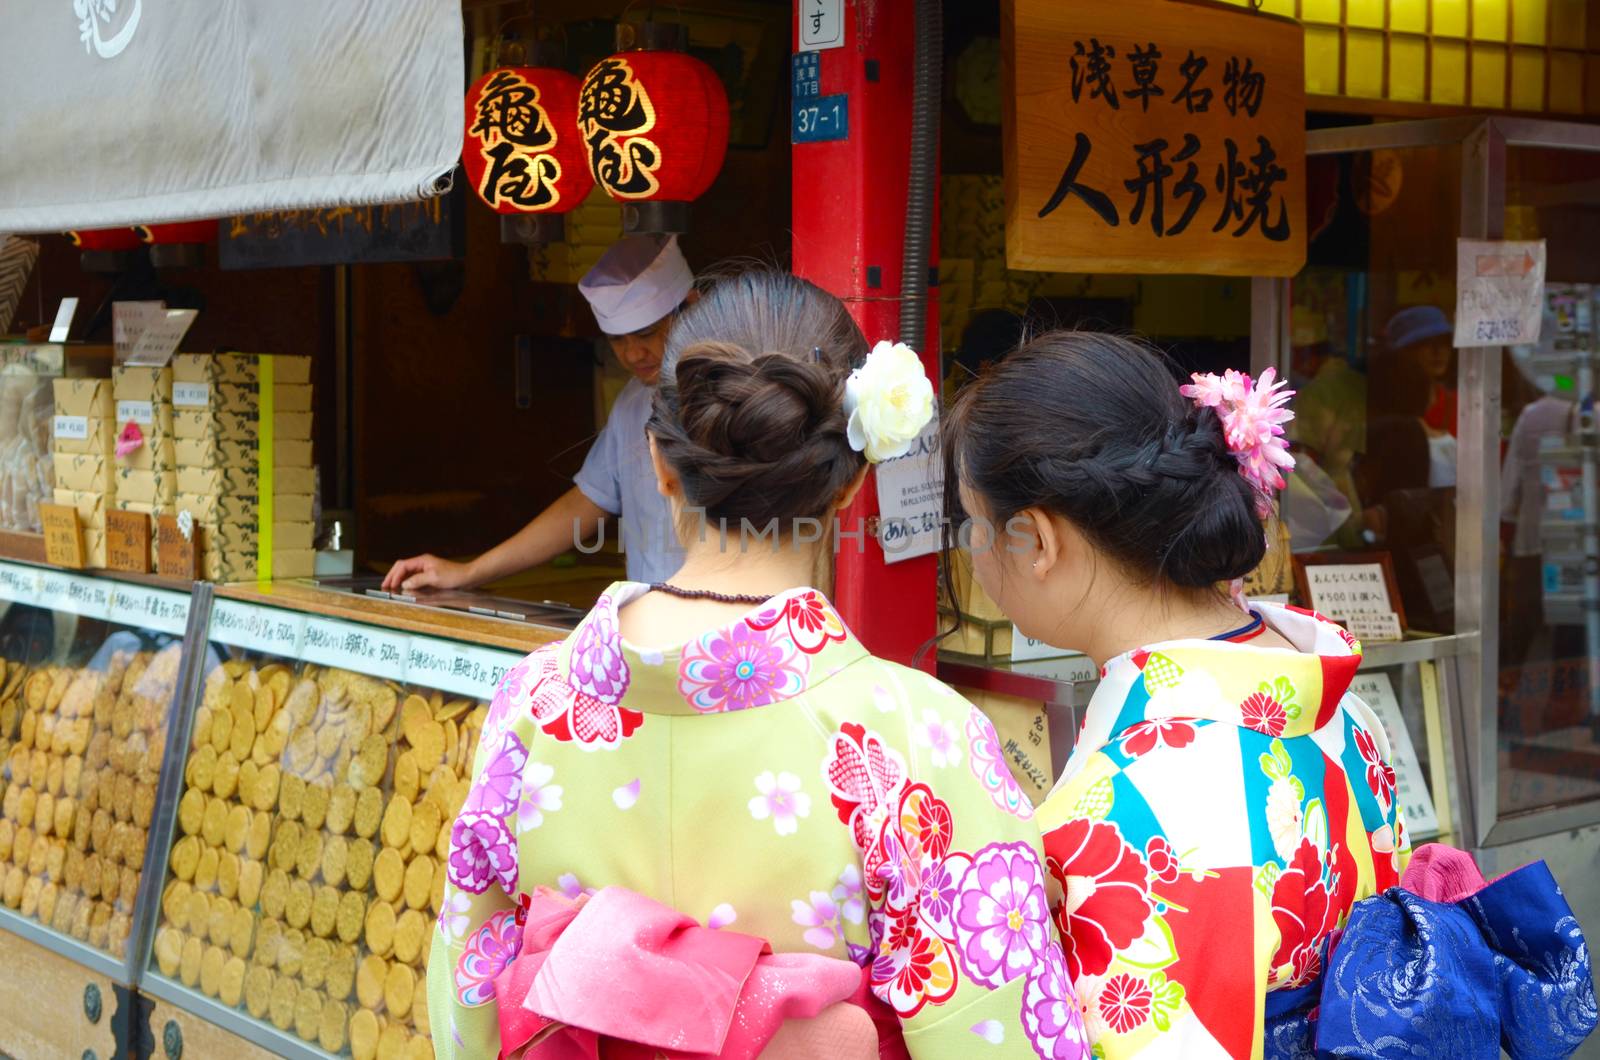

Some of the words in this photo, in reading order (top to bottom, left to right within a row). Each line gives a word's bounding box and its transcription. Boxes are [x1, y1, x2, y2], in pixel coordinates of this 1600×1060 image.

[1070, 38, 1266, 118] 浅草名物
[798, 105, 840, 133] 37-1
[1038, 132, 1291, 242] 人形焼
